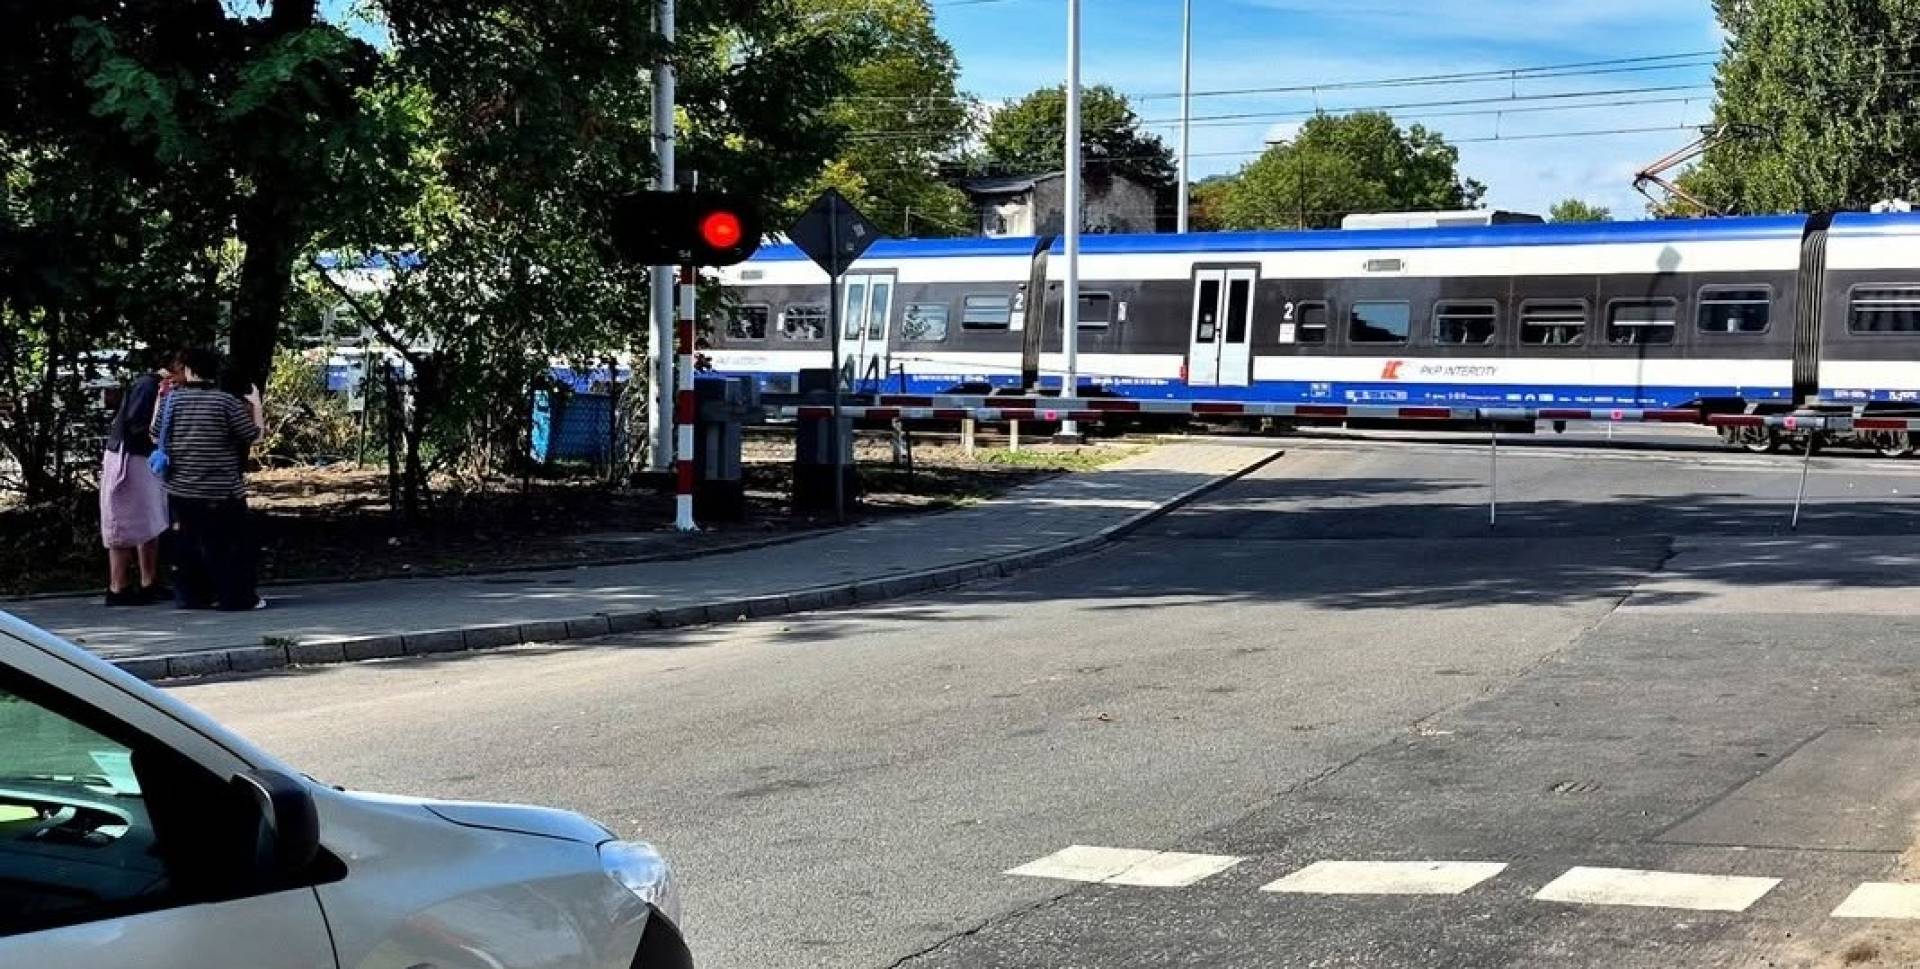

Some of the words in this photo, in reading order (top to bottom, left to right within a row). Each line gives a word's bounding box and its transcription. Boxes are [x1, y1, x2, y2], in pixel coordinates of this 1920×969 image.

[1014, 292, 1024, 310] 2
[1283, 301, 1294, 319] 2
[1443, 365, 1497, 377] INTERCITY
